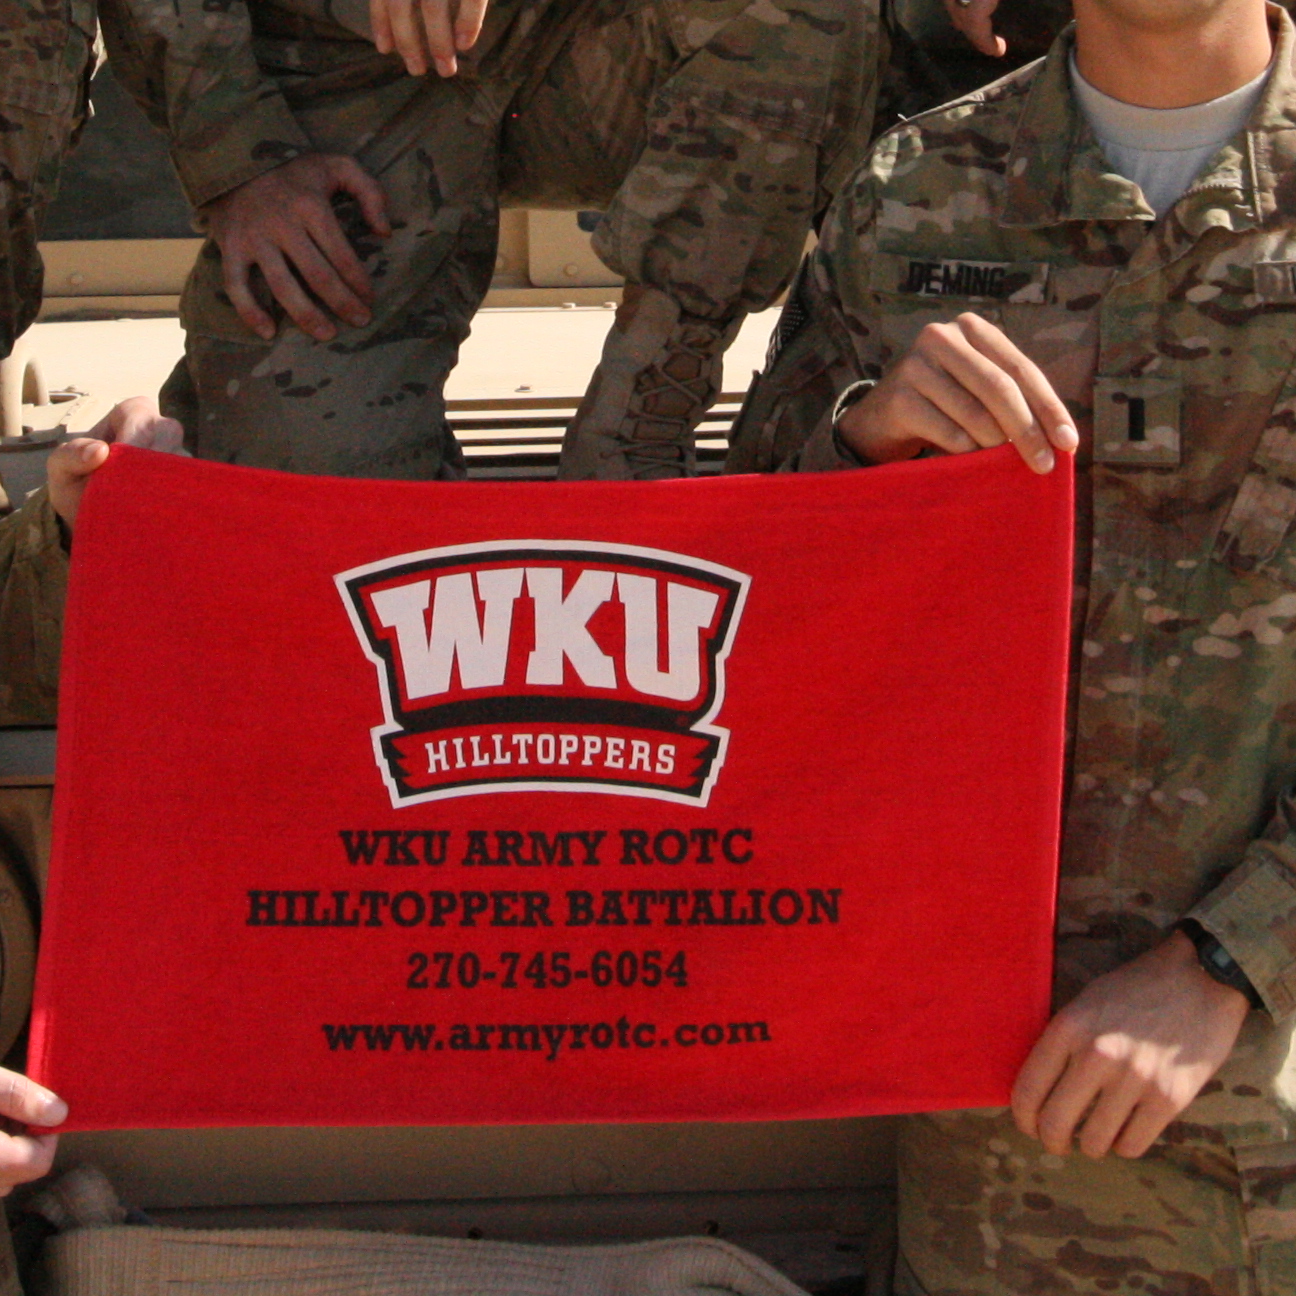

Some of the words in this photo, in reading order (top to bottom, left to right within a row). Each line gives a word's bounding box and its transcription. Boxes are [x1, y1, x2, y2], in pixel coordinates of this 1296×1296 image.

[907, 260, 1006, 298] DEMING
[369, 566, 720, 702] WKU
[425, 733, 678, 776] HILLTOPPERS
[338, 830, 451, 867] WKU
[461, 829, 608, 867] ARMY
[619, 828, 755, 866] ROTC
[245, 889, 554, 927] HILLTOPPER
[565, 888, 843, 926] BATTALION
[406, 950, 689, 990] 270-745-6054
[320, 1015, 772, 1061] www.armyrotc.com
